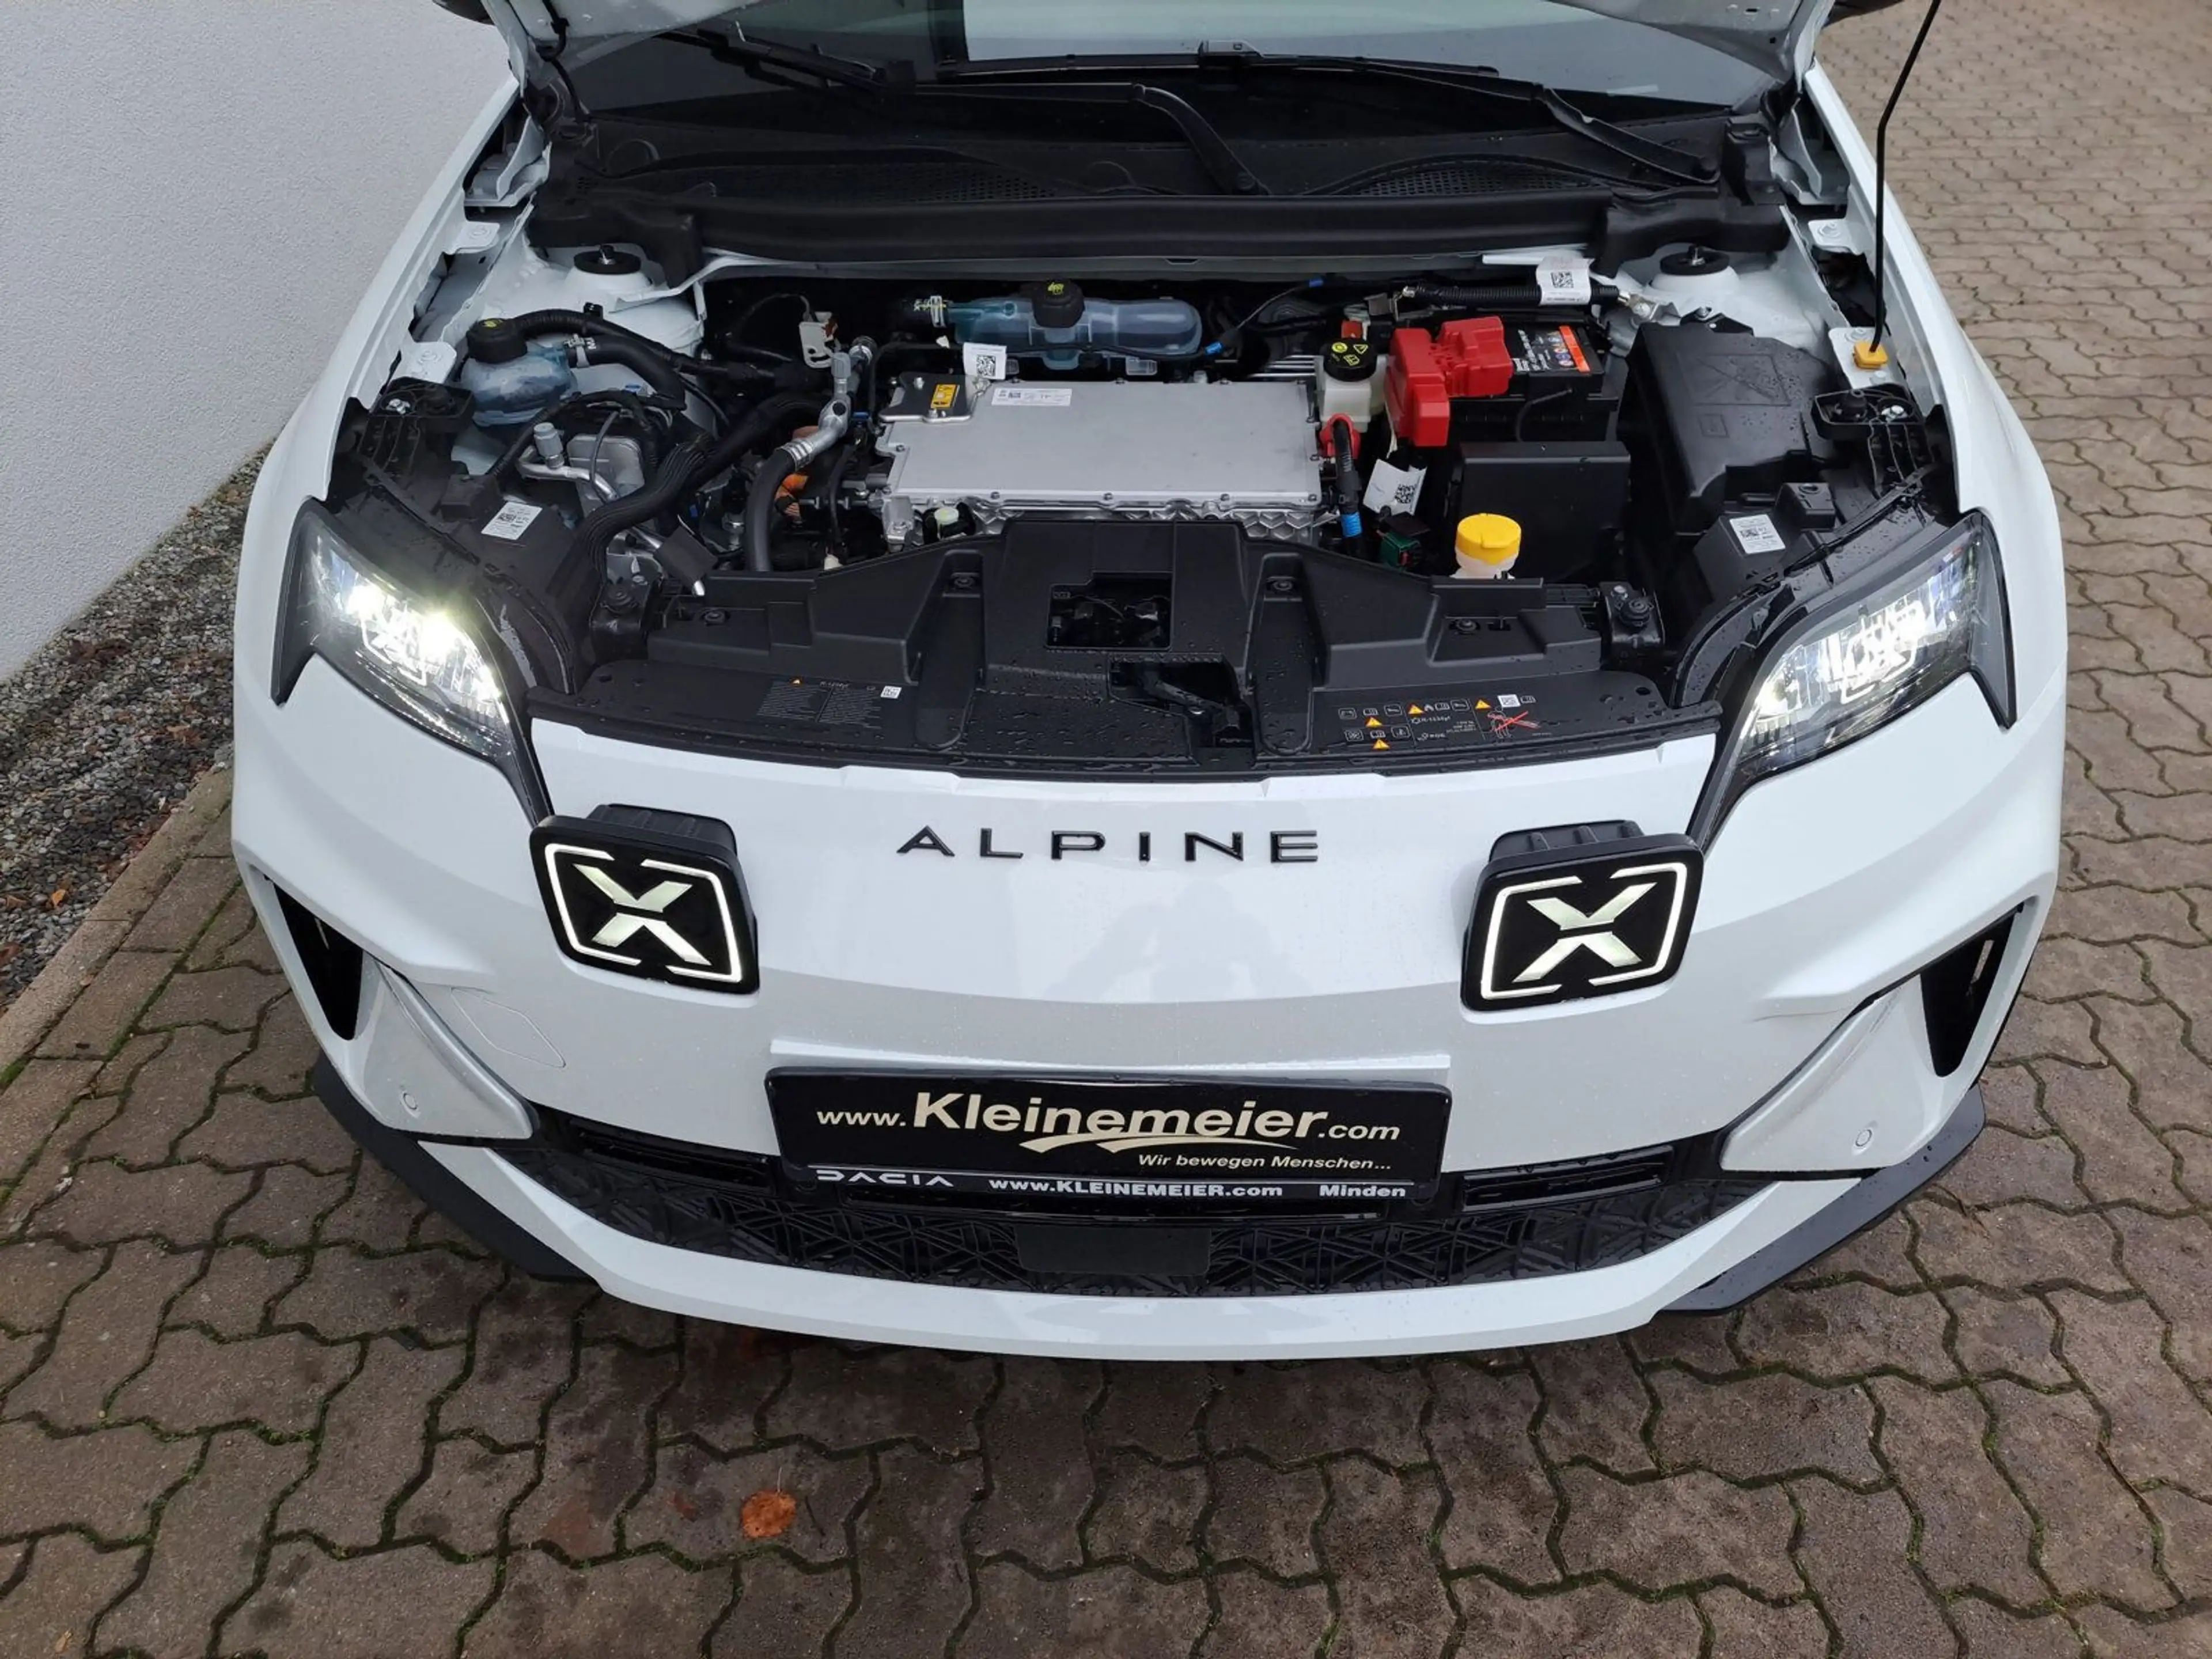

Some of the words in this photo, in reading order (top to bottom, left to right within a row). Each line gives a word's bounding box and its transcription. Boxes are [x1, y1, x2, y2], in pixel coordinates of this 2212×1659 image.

[896, 825, 1319, 863] ALPINE
[817, 1092, 1400, 1140] www.Kleinemeier.com
[1139, 1154, 1171, 1166] Wir
[1176, 1155, 1265, 1169] bewegen
[1271, 1156, 1391, 1170] Menschen...
[816, 1169, 954, 1187] DACIA
[989, 1180, 1283, 1197] www.KLEINEMEIER.com
[1319, 1184, 1406, 1198] Minden
